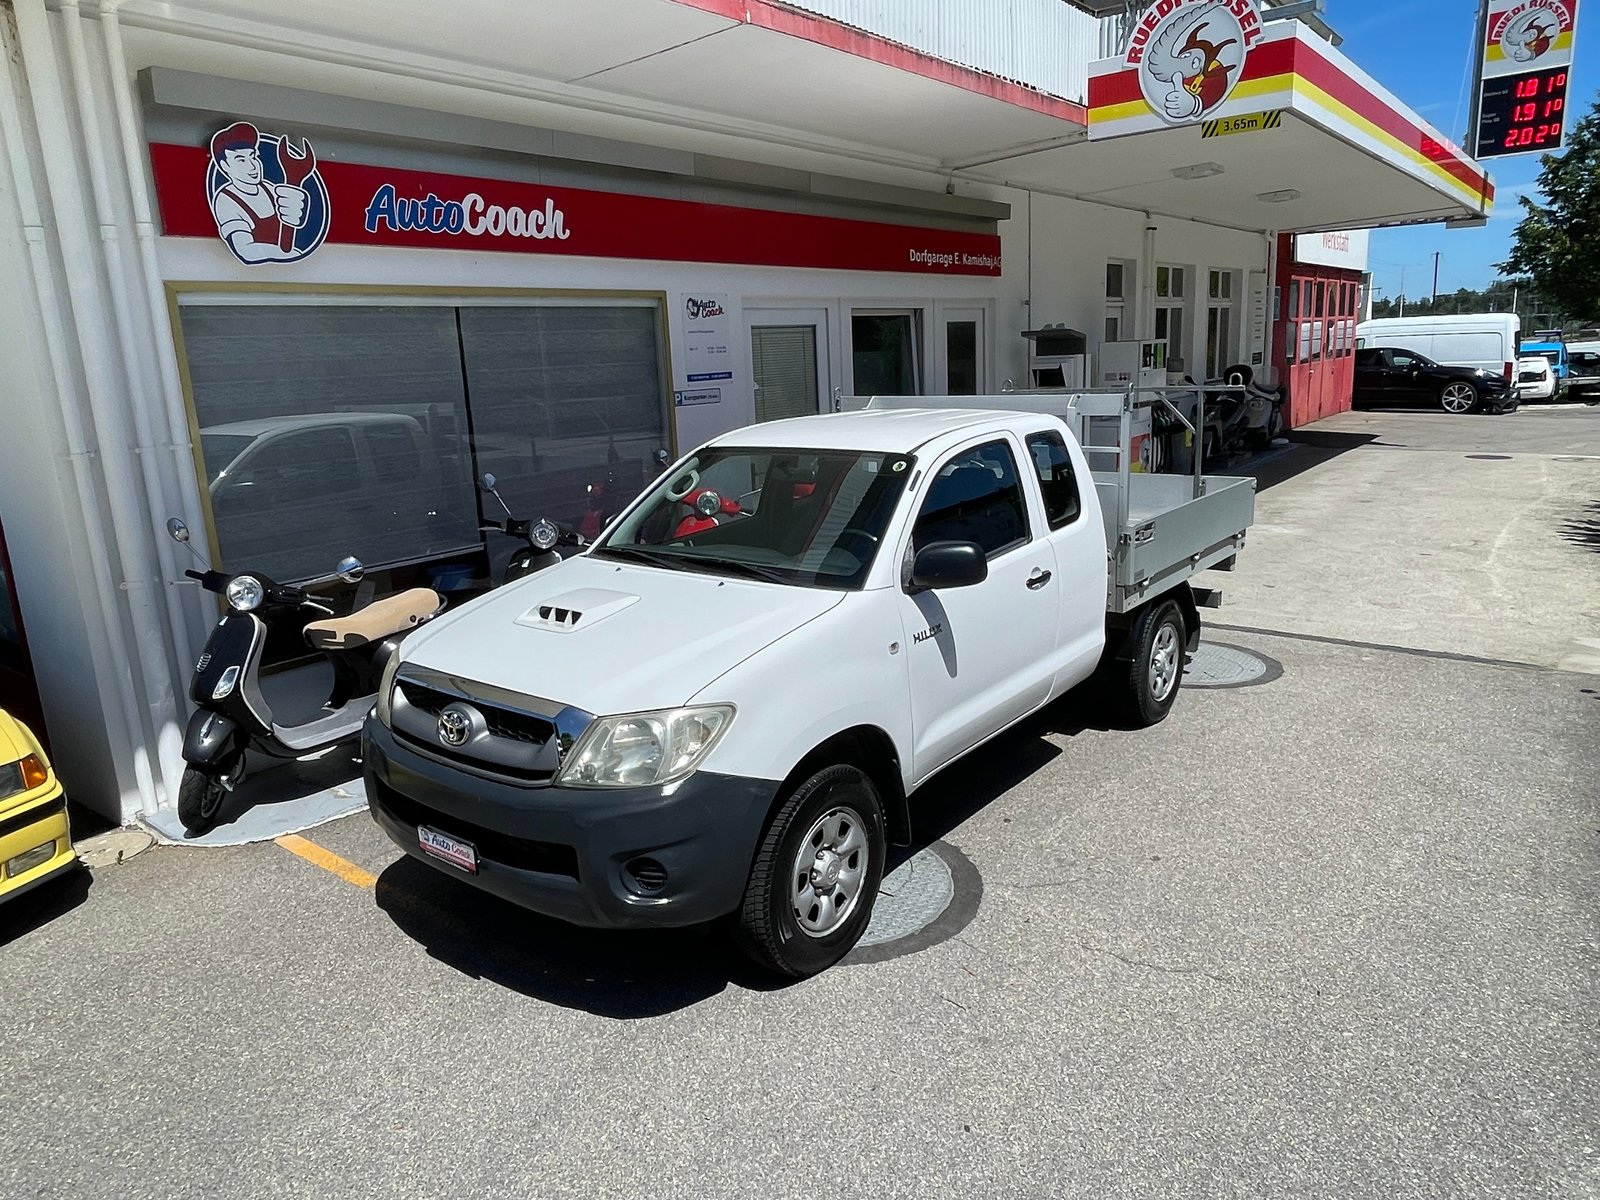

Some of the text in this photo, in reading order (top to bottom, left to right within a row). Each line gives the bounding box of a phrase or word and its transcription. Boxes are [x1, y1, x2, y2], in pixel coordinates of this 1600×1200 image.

[1493, 3, 1526, 39] RUEDI
[1223, 118, 1258, 132] 3.65m
[909, 248, 953, 267] Dorfgarage
[954, 252, 961, 265] E.
[963, 253, 993, 269] Kamishaj
[700, 299, 716, 309] Auto
[701, 304, 725, 318] Coach
[913, 623, 943, 645] HILUX
[431, 834, 451, 851] Auto
